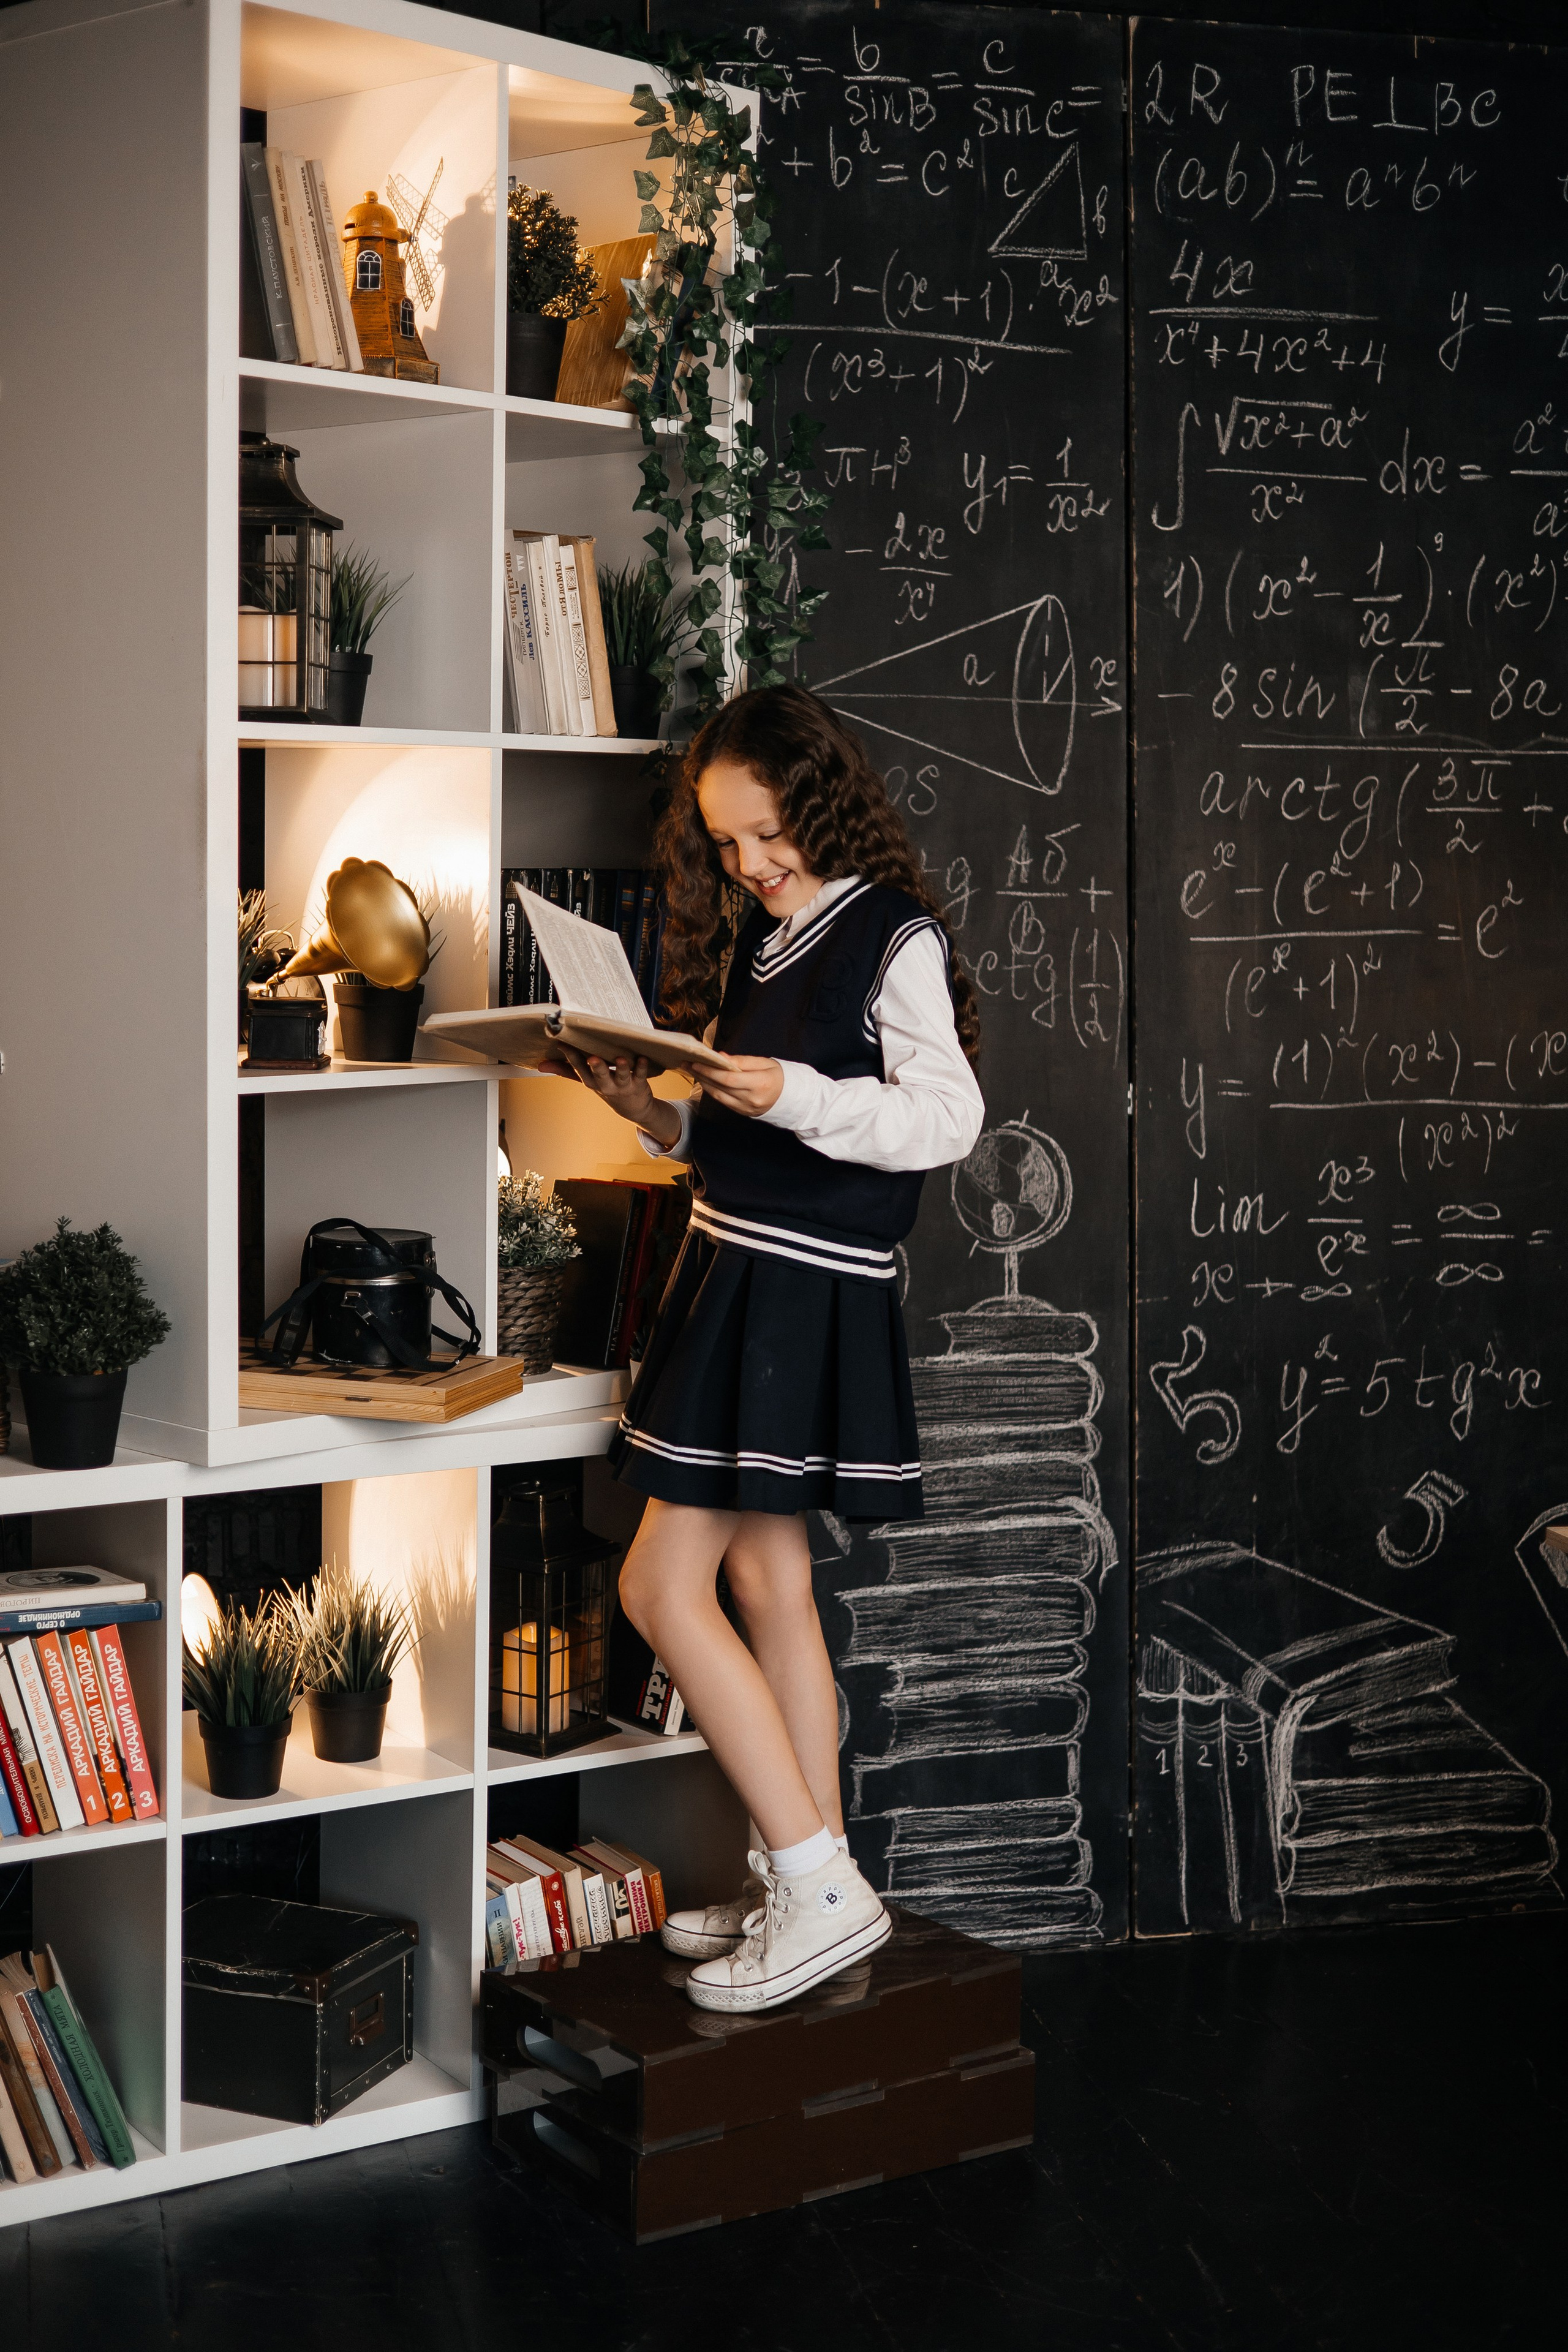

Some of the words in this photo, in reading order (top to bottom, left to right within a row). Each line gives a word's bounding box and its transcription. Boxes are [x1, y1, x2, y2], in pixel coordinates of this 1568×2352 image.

[520, 582, 533, 639] КАССИЛЬ
[505, 937, 516, 972] Хэдли
[18, 1610, 81, 1623] ОРДЖОНИКИДЗЕ
[36, 1620, 58, 1630] СЕРГО
[44, 1647, 70, 1706] ГАЙДАР
[74, 1644, 98, 1701] ГАЙДАР
[104, 1643, 128, 1699] ГАЙДАР
[59, 1706, 91, 1778] АРКАДИЙ
[87, 1703, 117, 1774] АРКАДИЙ
[116, 1702, 146, 1773] АРКАДИЙ
[86, 1795, 97, 1812] 1
[111, 1791, 126, 1811] 2
[139, 1790, 153, 1808] 3
[52, 2004, 70, 2029] МЯТА
[64, 2034, 96, 2084] ХОЛОДНАЯ
